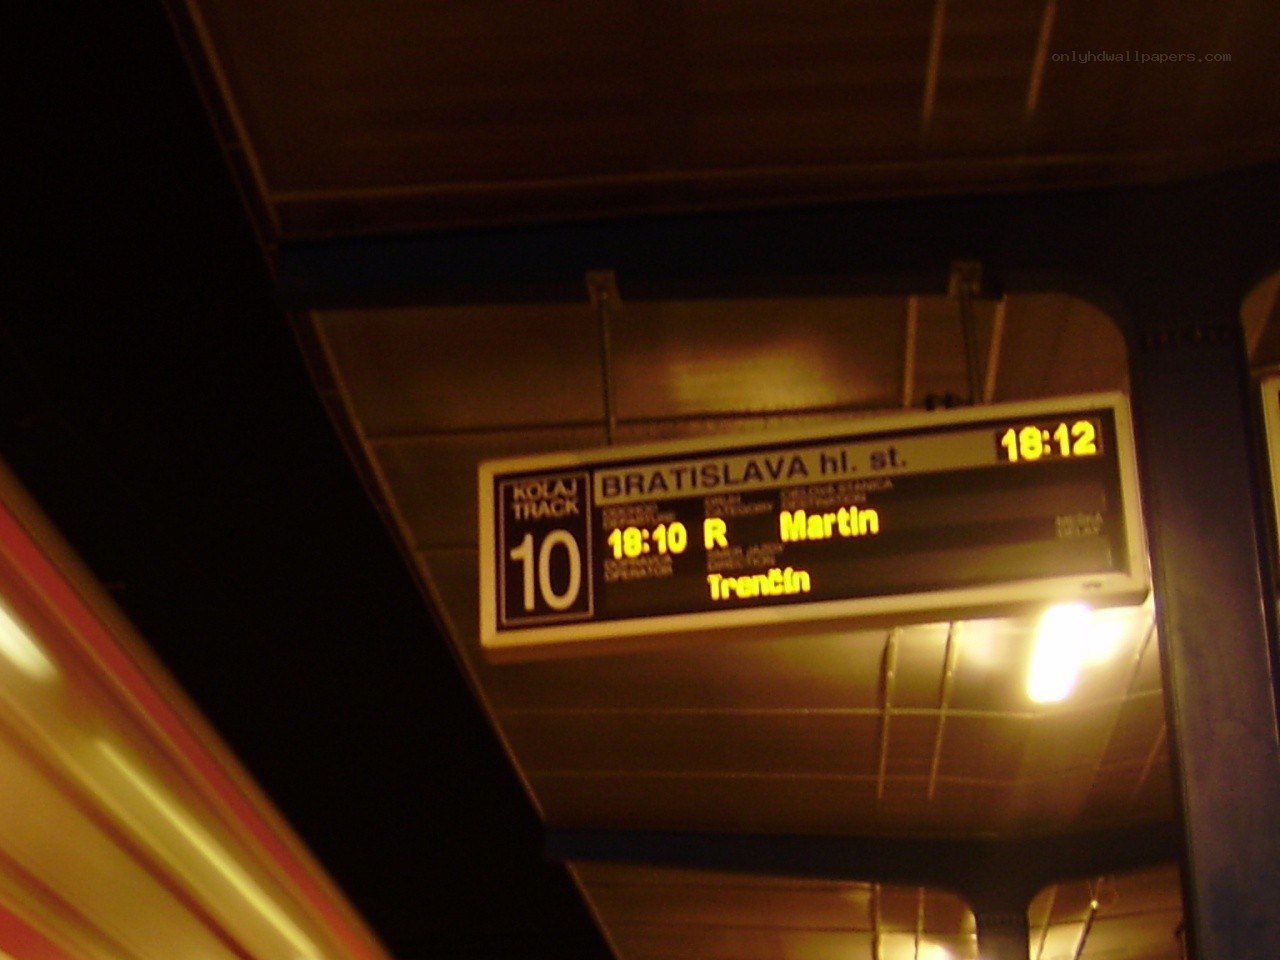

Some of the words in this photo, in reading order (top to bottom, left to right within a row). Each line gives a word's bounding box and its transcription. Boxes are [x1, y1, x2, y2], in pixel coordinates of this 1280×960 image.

[1001, 420, 1097, 463] 18:12
[602, 454, 808, 498] BRATISLAVA
[821, 448, 857, 475] hl.
[871, 446, 907, 471] st.
[513, 498, 579, 520] TRACK
[608, 521, 688, 560] 18:10
[703, 517, 729, 550] R
[780, 505, 879, 542] Martin
[510, 529, 582, 612] 10
